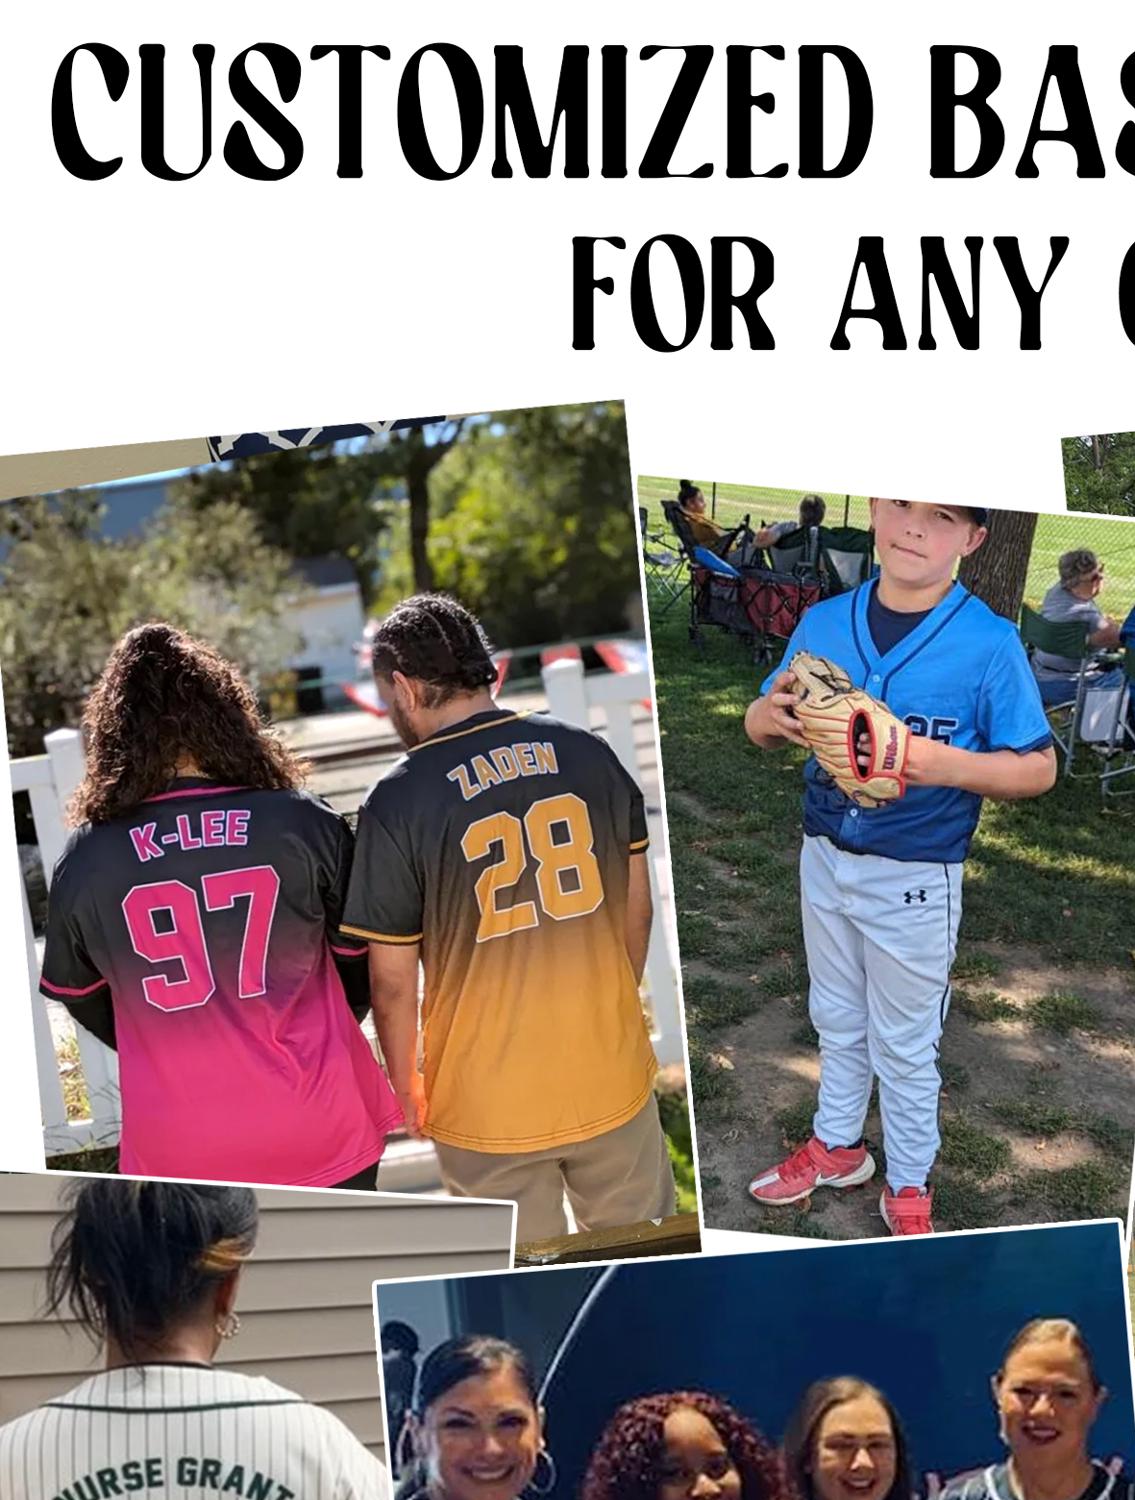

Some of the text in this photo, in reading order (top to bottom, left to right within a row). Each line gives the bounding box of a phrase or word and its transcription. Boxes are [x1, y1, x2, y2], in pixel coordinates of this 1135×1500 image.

[446, 739, 559, 801] ZADEN
[129, 809, 251, 862] K-LEE
[460, 791, 605, 943] 28
[121, 864, 281, 1012] 97
